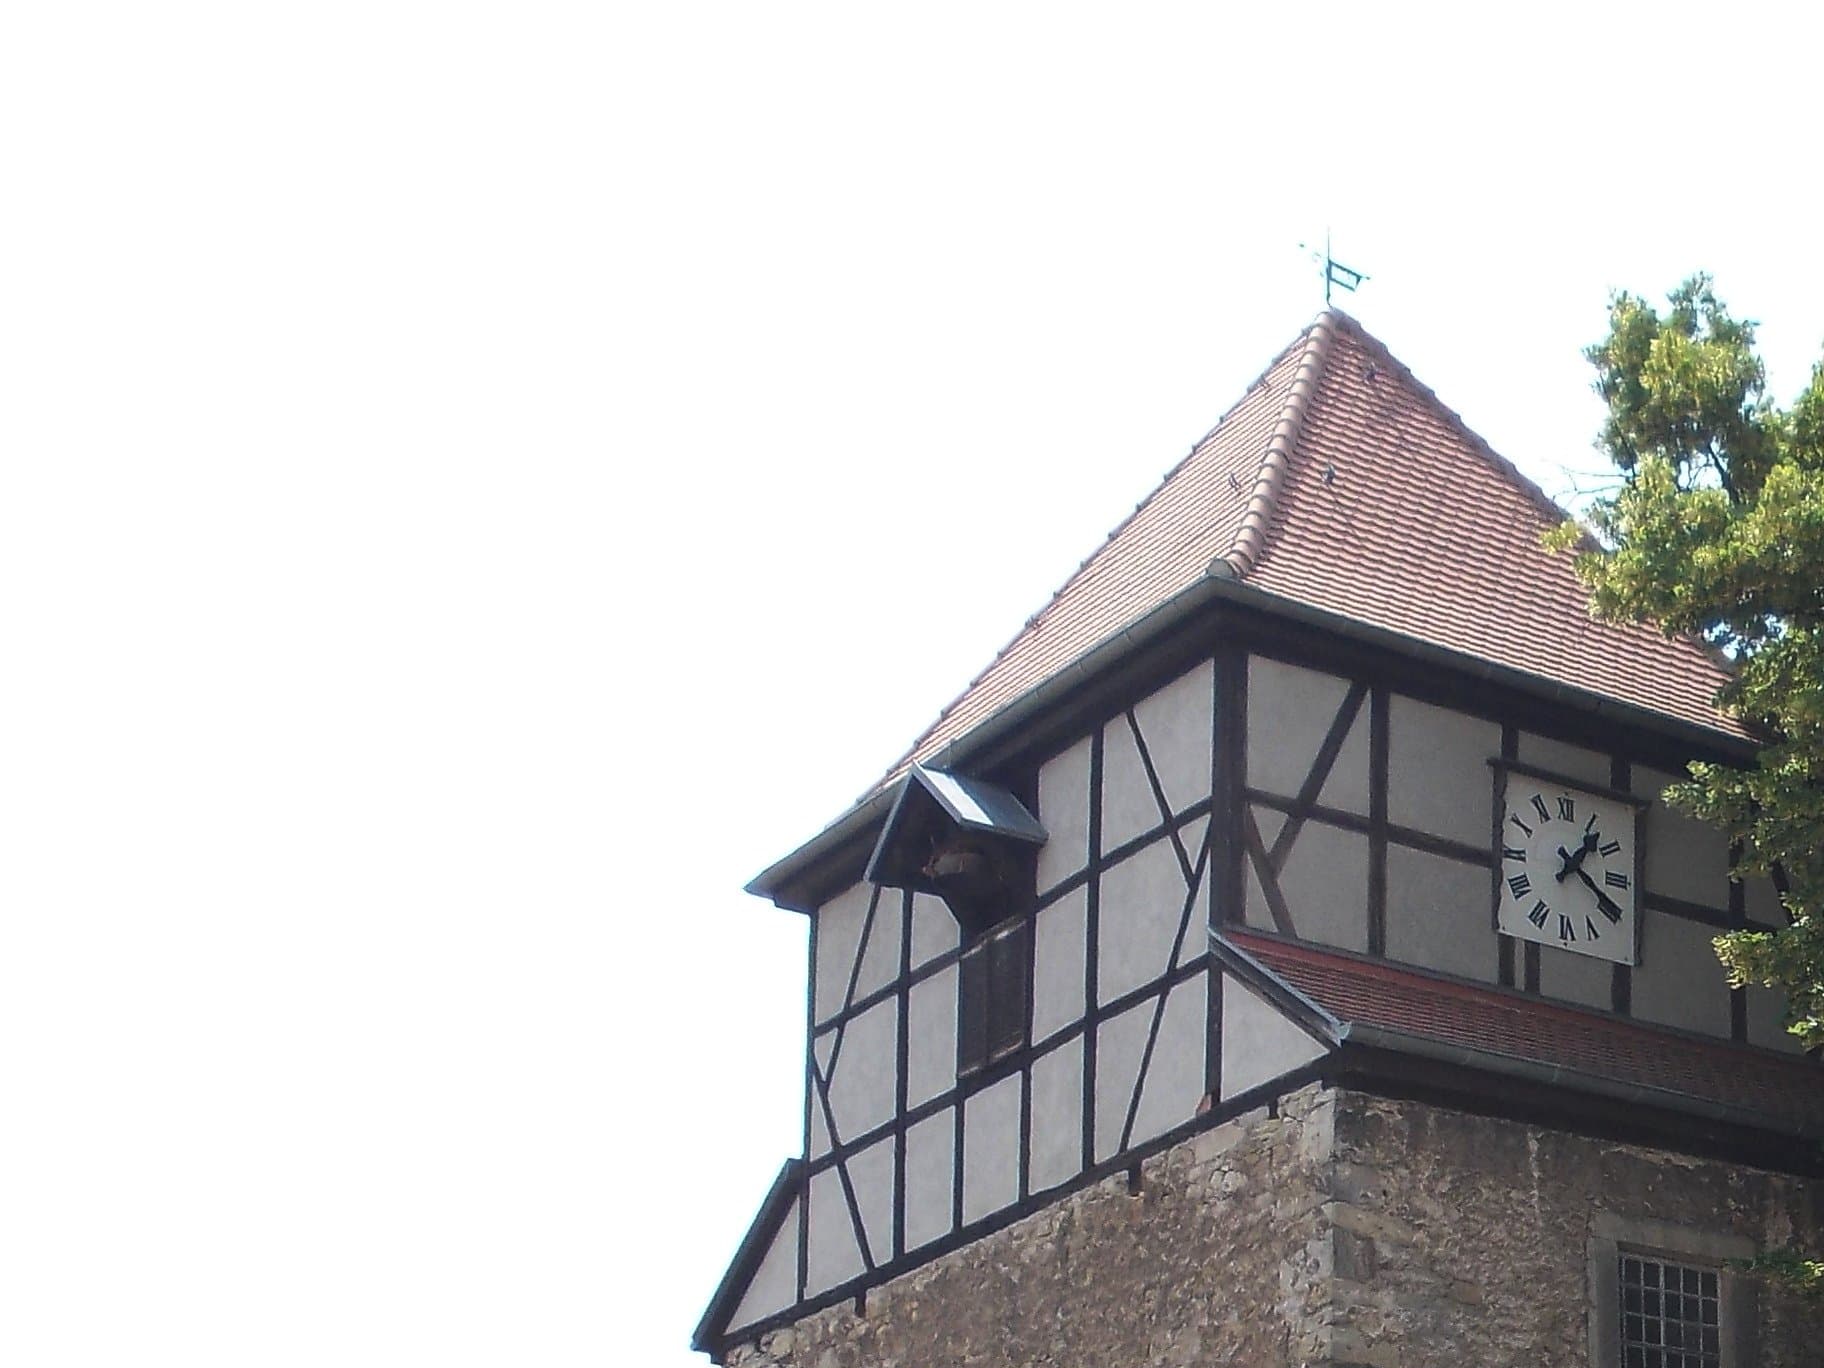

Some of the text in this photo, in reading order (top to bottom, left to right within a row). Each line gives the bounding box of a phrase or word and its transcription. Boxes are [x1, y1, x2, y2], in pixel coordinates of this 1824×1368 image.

[1556, 797, 1574, 823] XII
[1511, 813, 1532, 838] X
[1599, 840, 1620, 857] II
[1605, 870, 1627, 890] III
[1528, 899, 1550, 929] VII
[1559, 912, 1576, 941] VI
[1585, 914, 1600, 941] V
